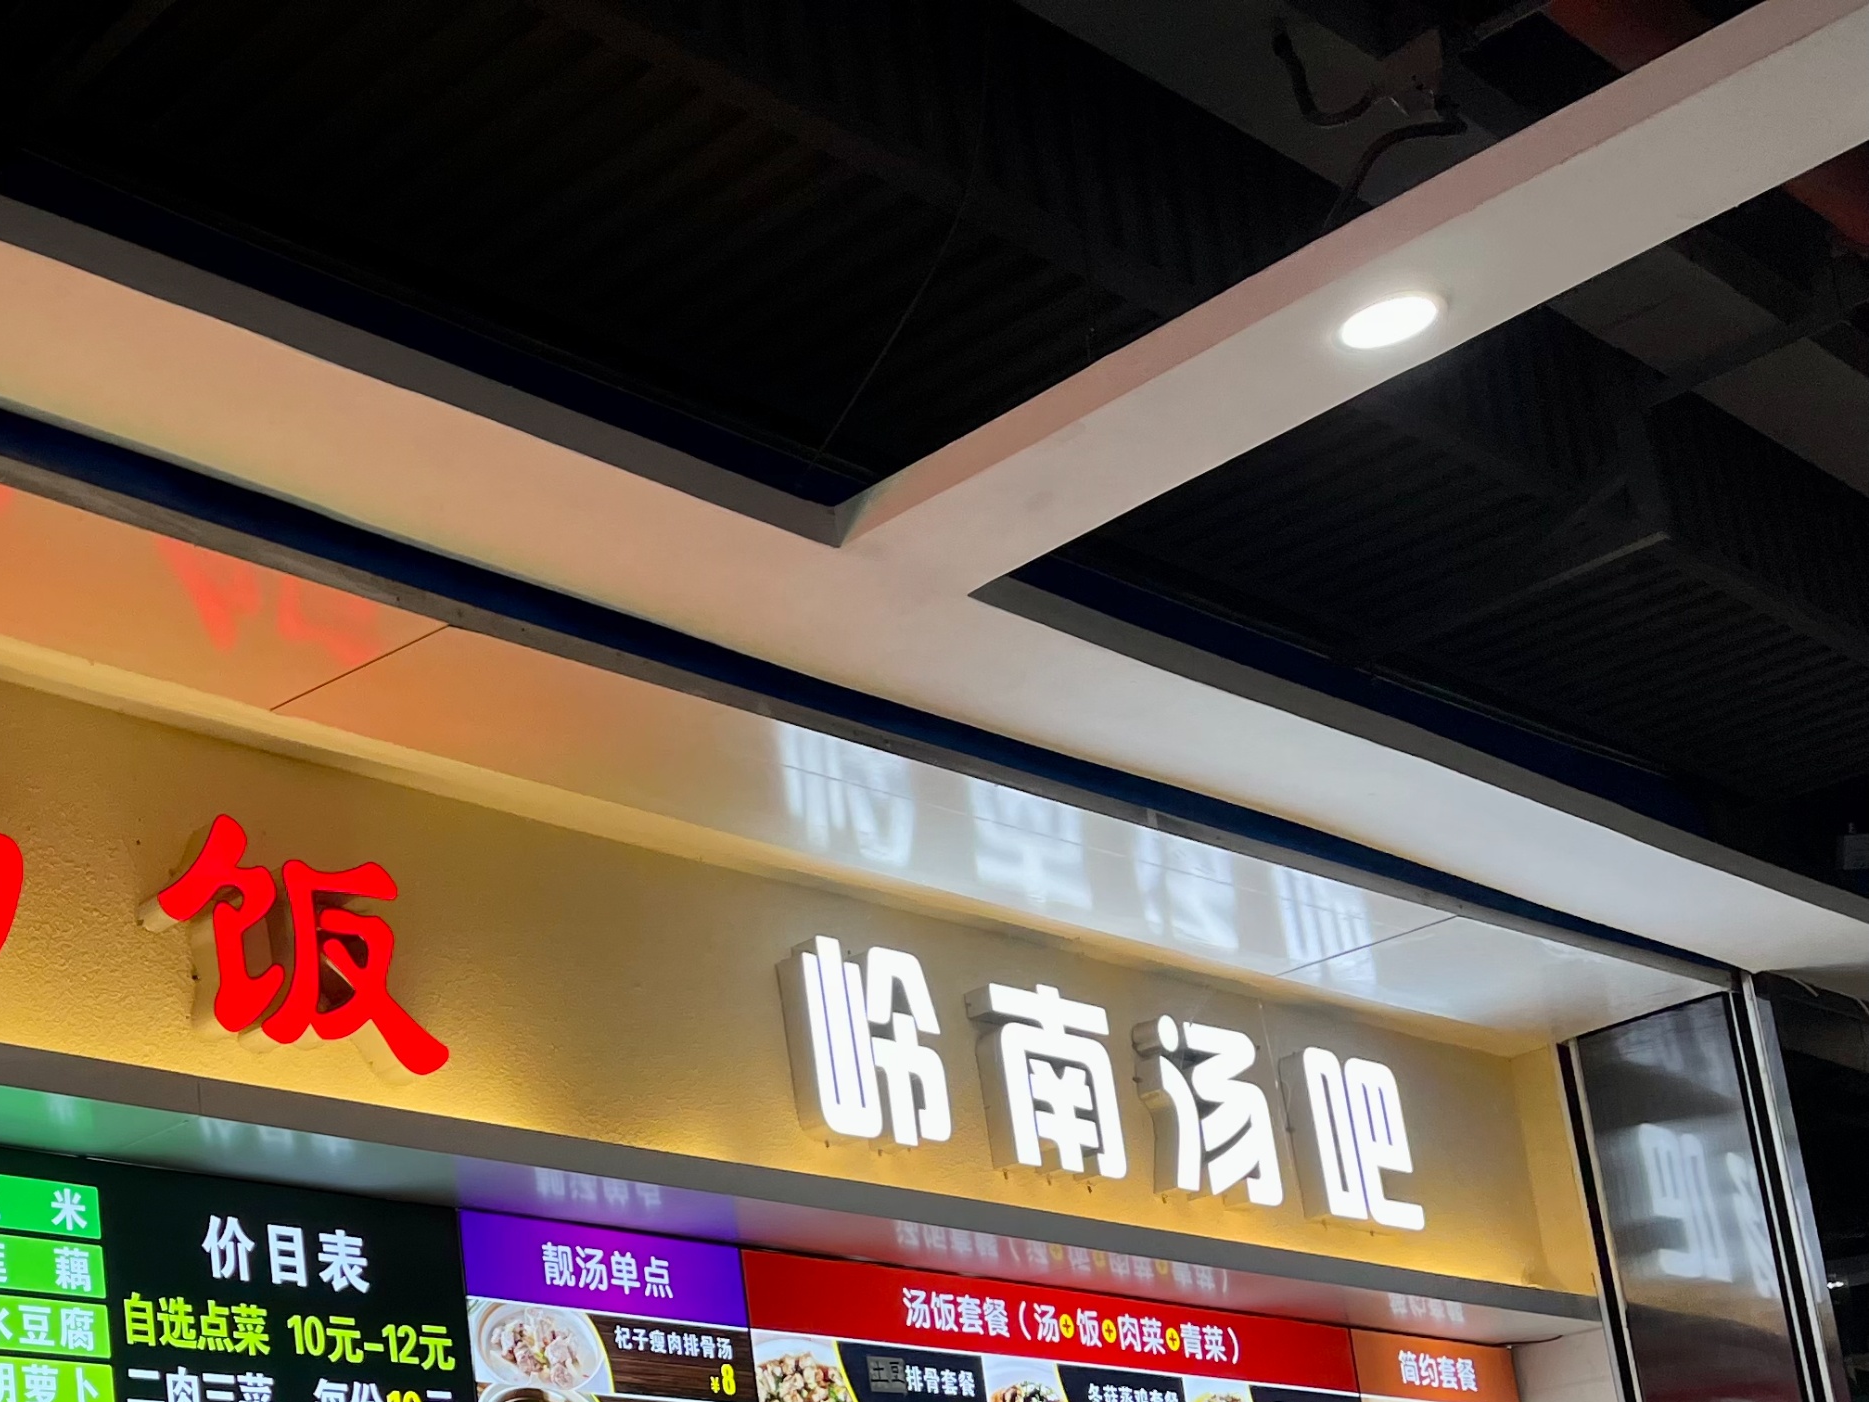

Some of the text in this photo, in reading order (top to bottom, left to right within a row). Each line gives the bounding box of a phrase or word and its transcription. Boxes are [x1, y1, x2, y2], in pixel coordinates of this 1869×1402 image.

[802, 934, 1425, 1231] 岭南汤吧
[201, 1214, 371, 1294] 价目表
[540, 1241, 675, 1299] 靓汤单点
[123, 1291, 456, 1371] 自选点菜 10元-12元
[613, 1324, 734, 1361] 杞子瘦肉排骨汤
[1397, 1349, 1479, 1393] 简约套餐
